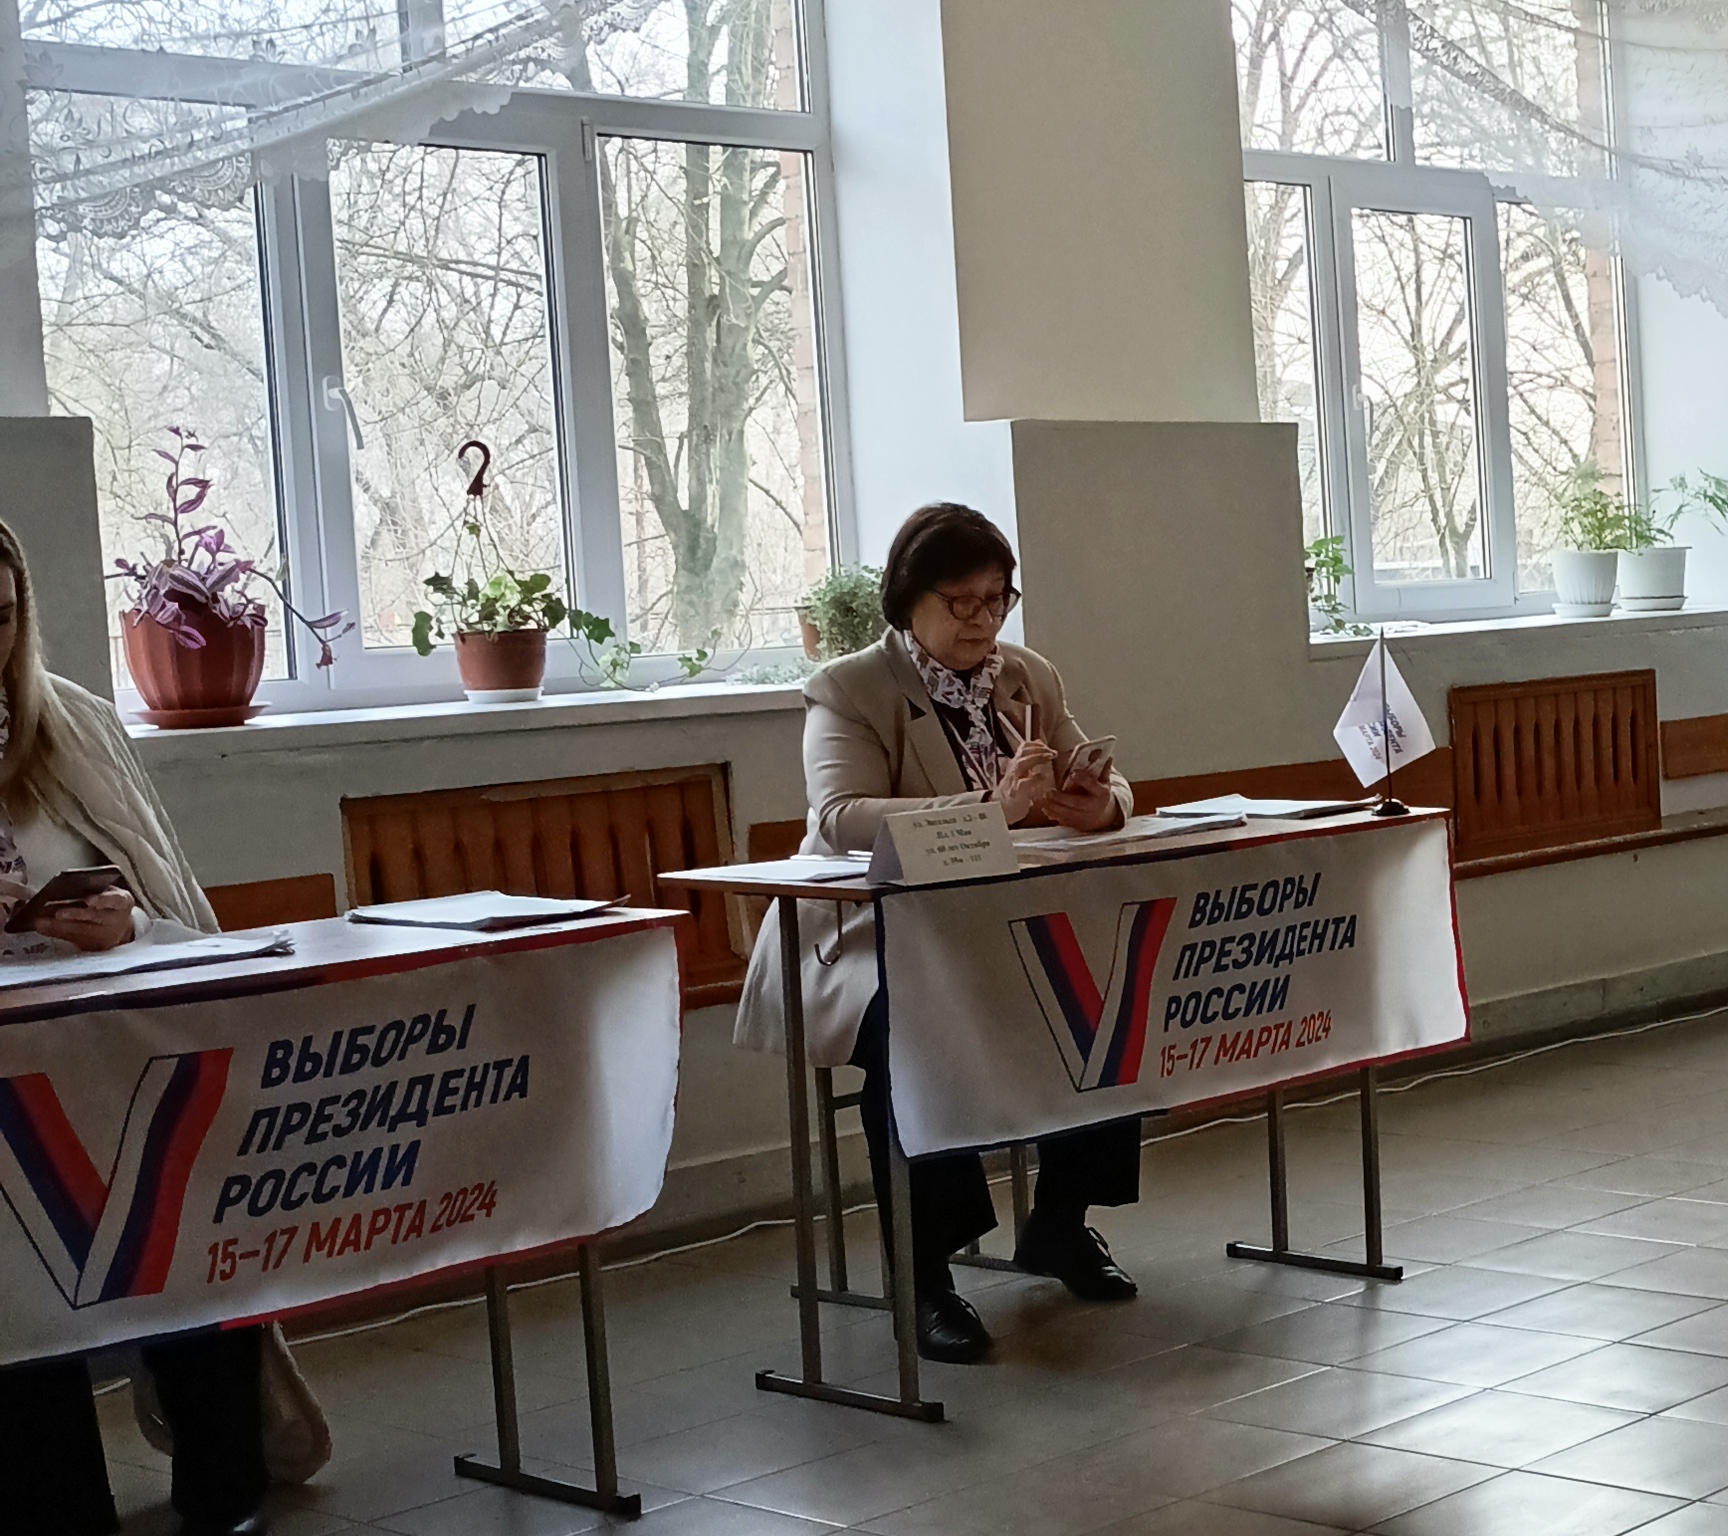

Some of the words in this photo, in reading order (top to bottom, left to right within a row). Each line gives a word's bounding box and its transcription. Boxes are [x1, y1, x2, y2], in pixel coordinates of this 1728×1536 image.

[1188, 872, 1322, 930] ВЫБОРЫ
[1172, 914, 1358, 982] ПРЕЗИДЕНТА
[1163, 974, 1291, 1033] РОССИИ
[1213, 1020, 1294, 1066] МАРТА
[1295, 1008, 1332, 1048] 2024
[260, 1003, 477, 1090] ВЫБОРЫ
[237, 1054, 531, 1157] ПРЕЗИДЕНТА
[212, 1139, 422, 1225] РОССИИ
[302, 1199, 428, 1265] МАРТА
[429, 1179, 499, 1235] 2024
